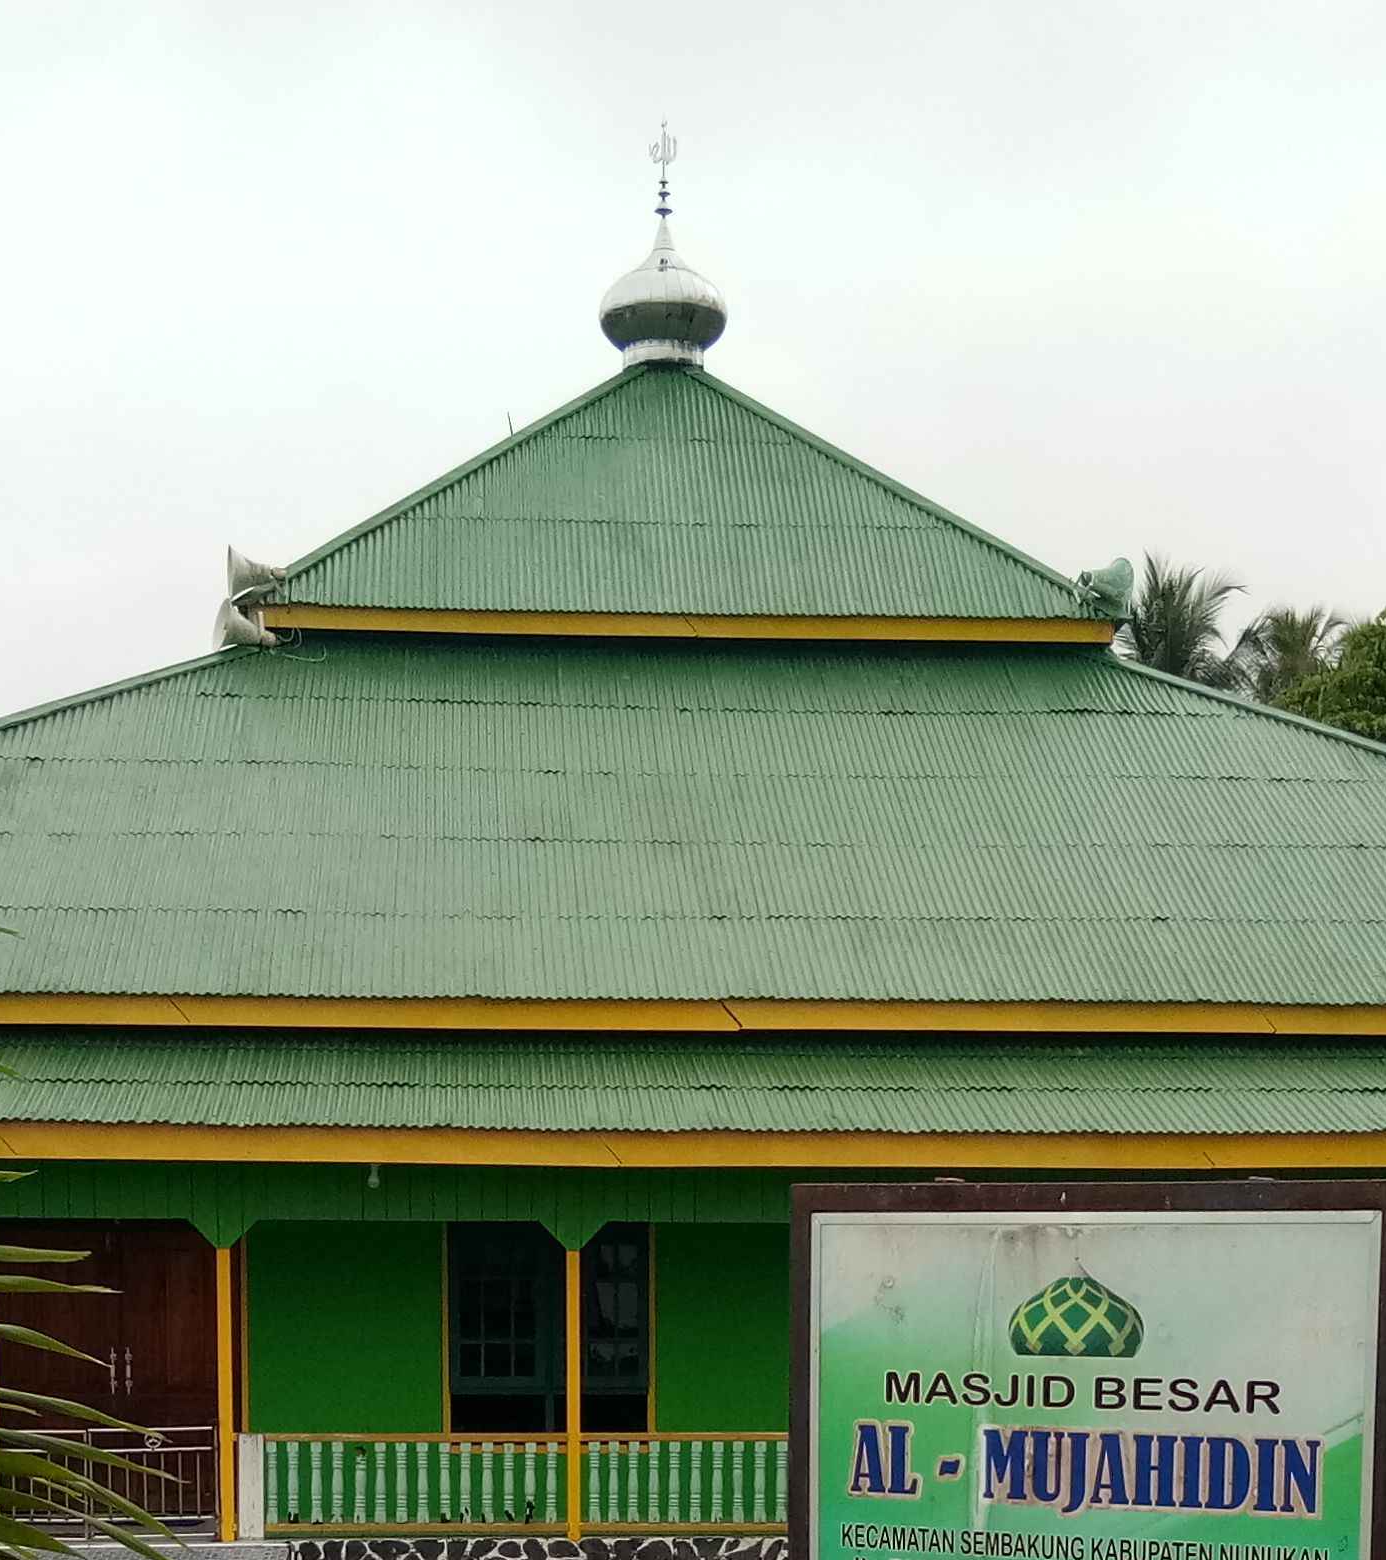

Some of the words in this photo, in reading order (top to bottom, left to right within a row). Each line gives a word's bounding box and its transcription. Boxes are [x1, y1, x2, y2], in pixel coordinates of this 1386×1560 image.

[884, 1370, 1076, 1408] MASJID
[1093, 1376, 1281, 1415] BESAR
[849, 1424, 919, 1495] AL
[938, 1459, 961, 1476] -
[982, 1428, 1322, 1515] MUJAHIDIN
[840, 1523, 955, 1554] KECAMATAN
